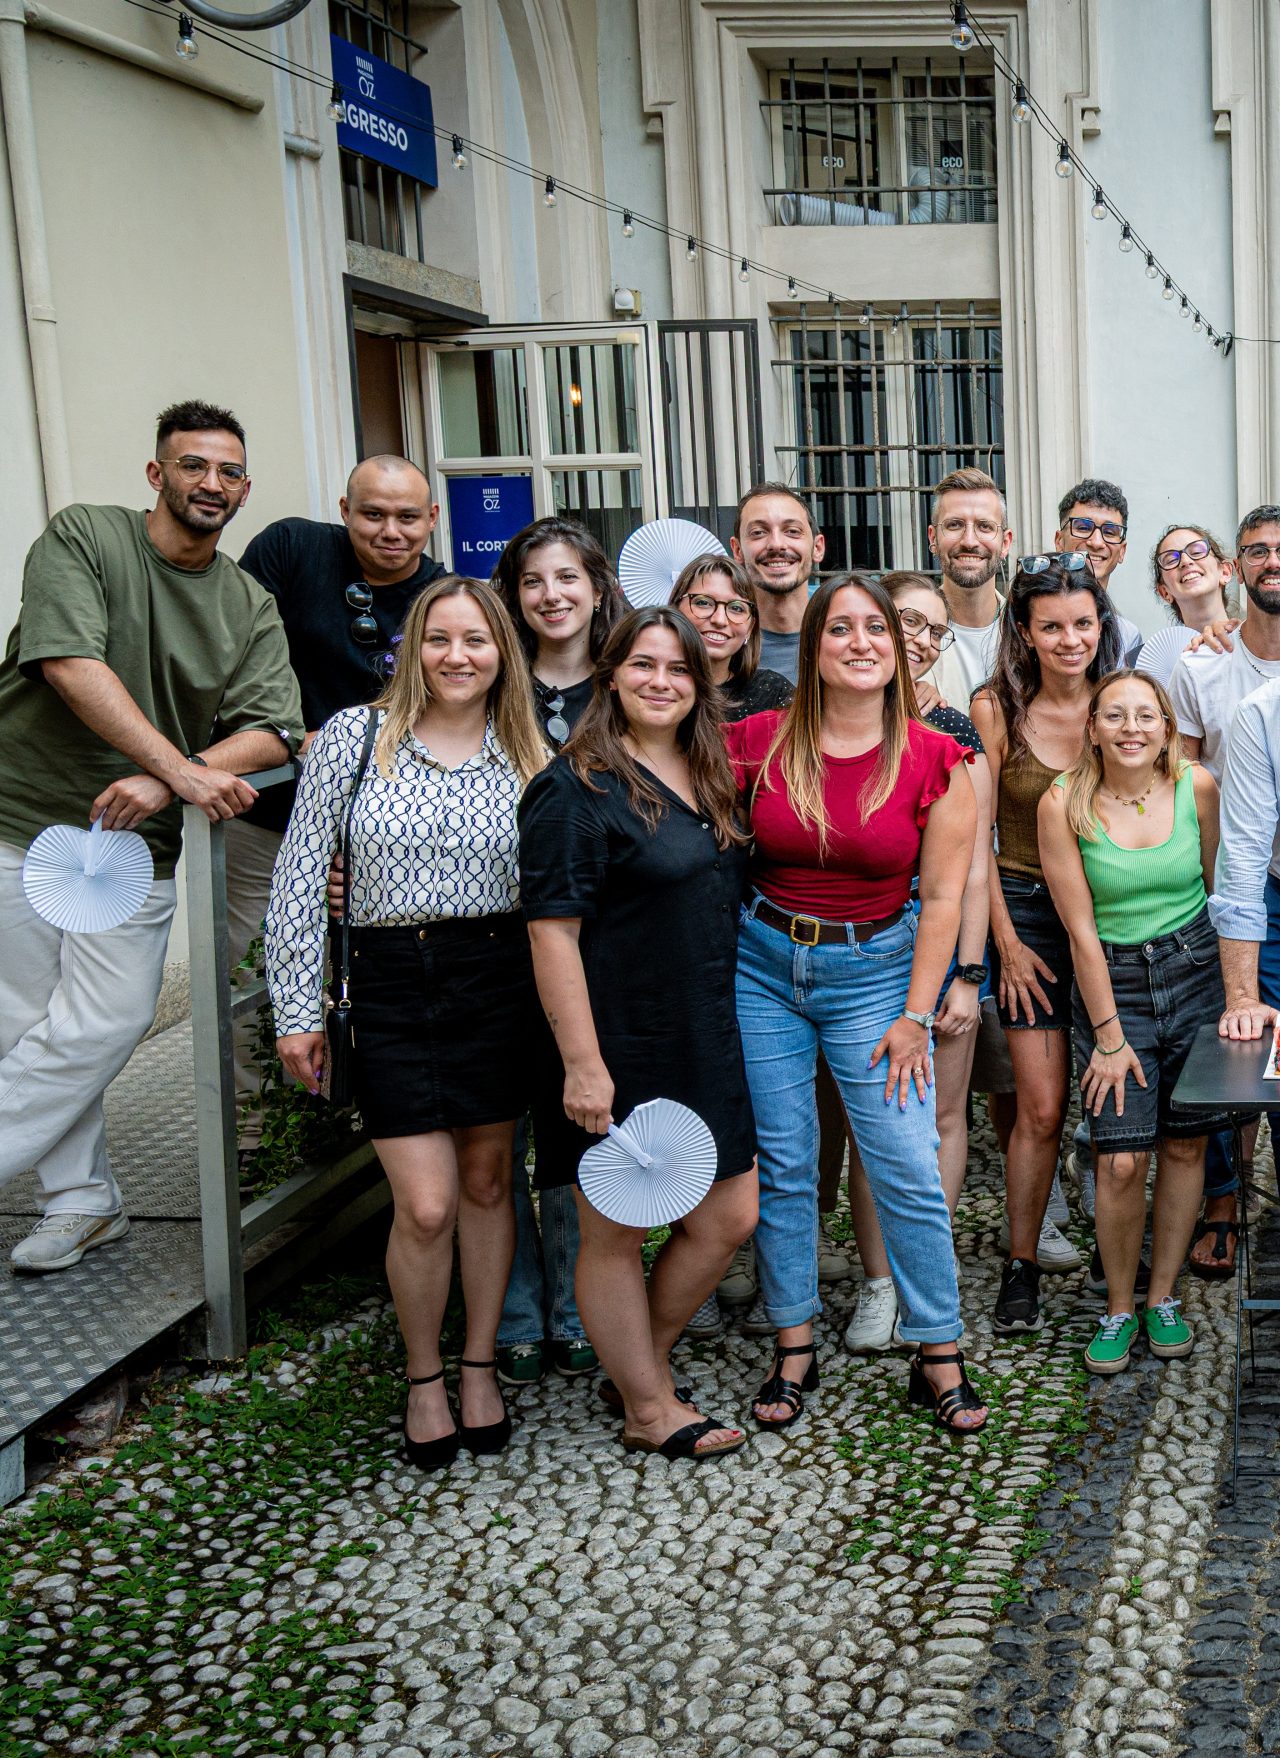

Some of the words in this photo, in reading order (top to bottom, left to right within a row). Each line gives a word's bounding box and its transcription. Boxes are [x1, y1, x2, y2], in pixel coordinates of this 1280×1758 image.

[342, 100, 408, 151] GRESSO
[942, 156, 963, 168] eco
[462, 541, 474, 552] IL
